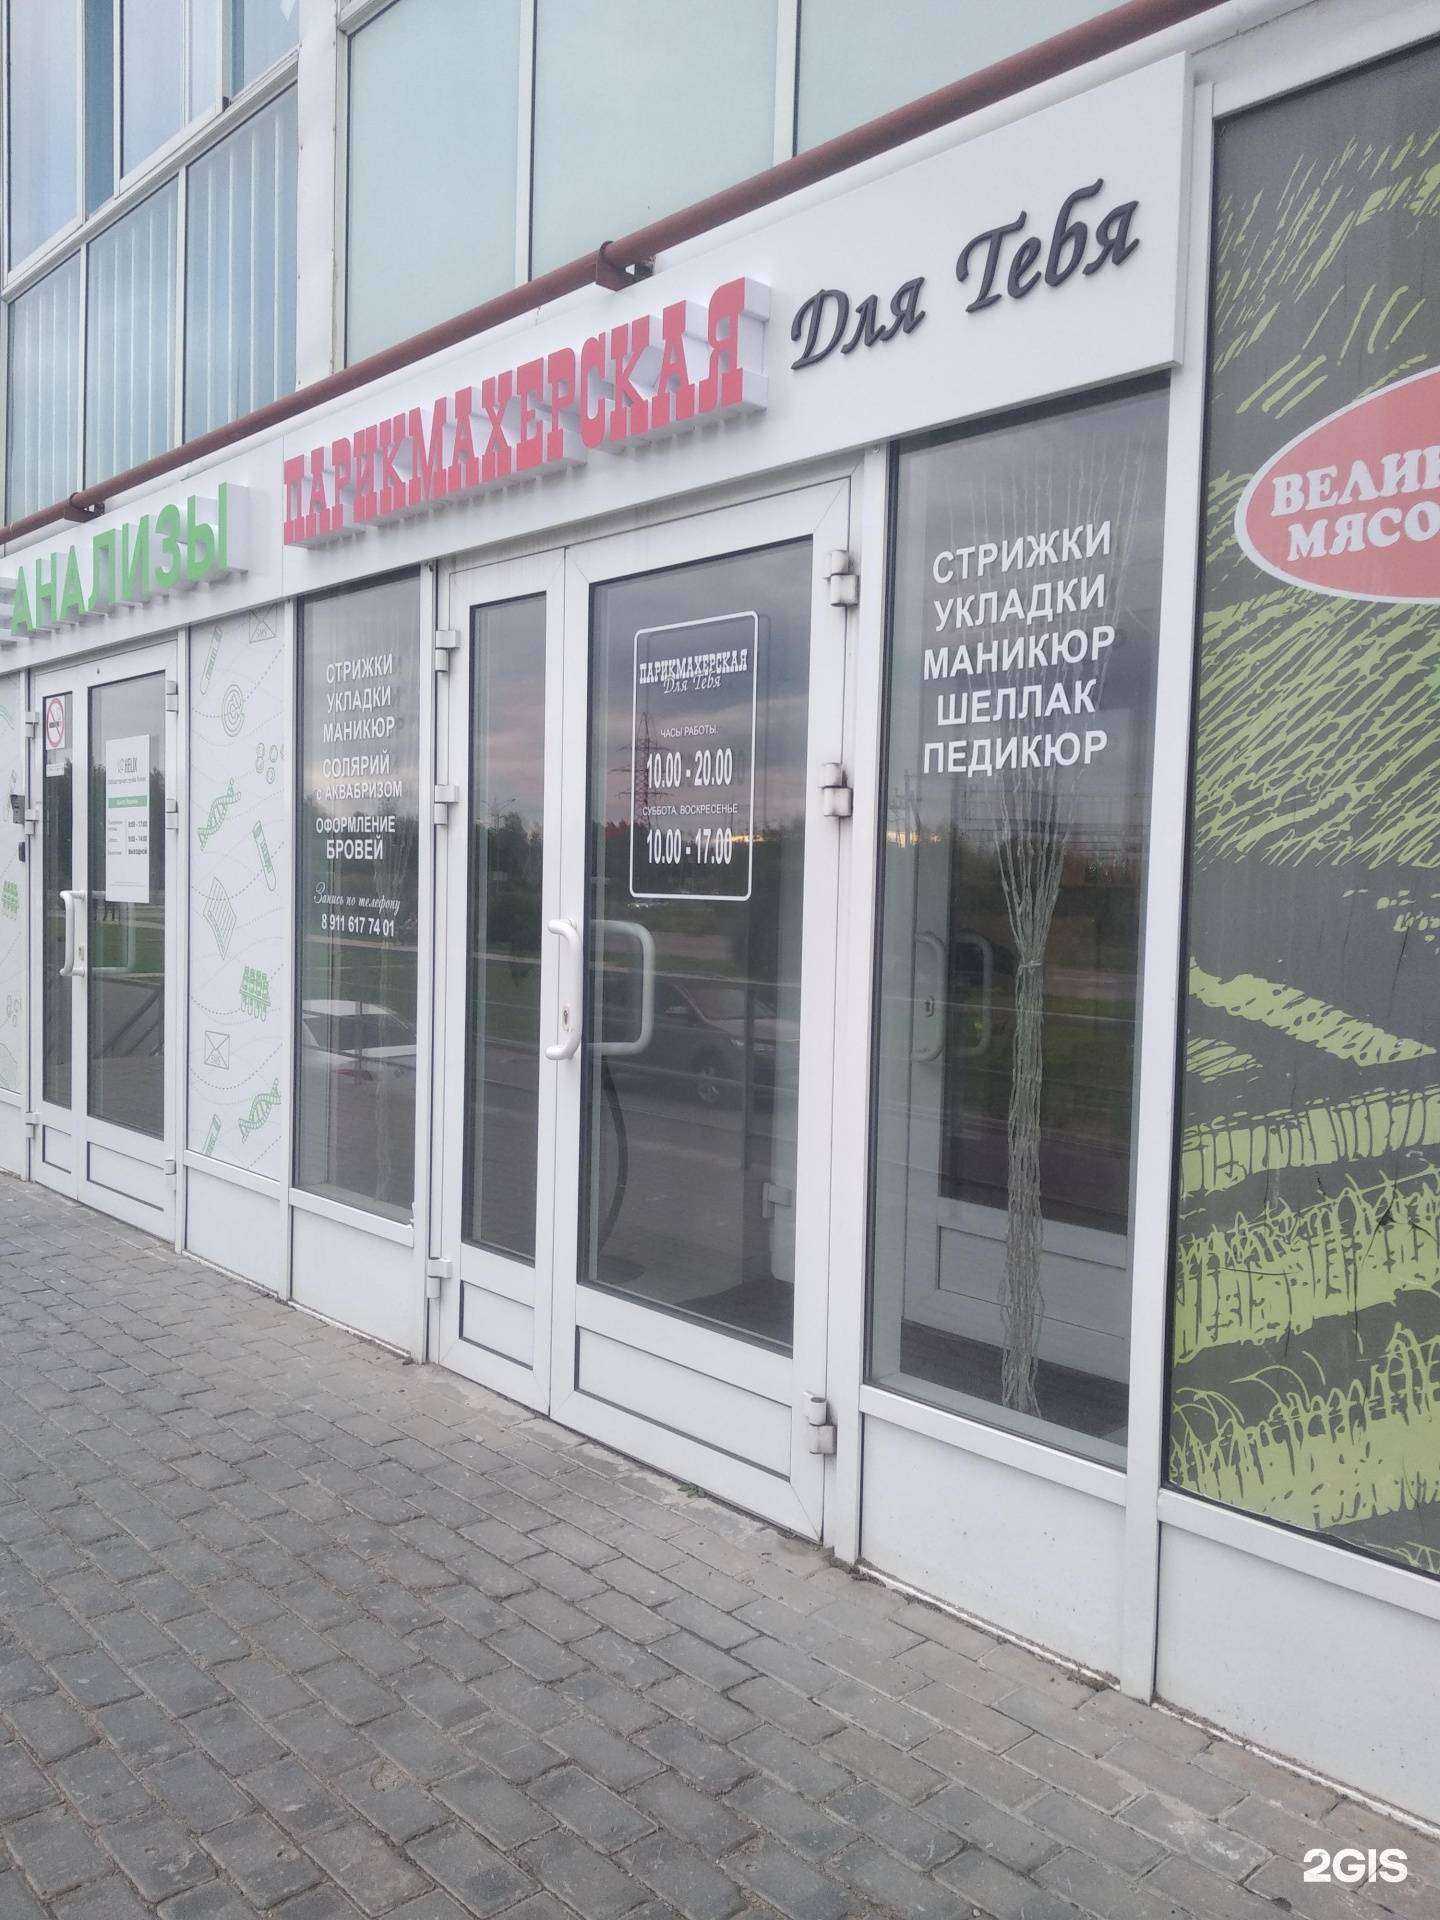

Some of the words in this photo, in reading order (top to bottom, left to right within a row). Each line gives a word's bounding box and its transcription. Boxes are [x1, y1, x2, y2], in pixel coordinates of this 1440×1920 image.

[790, 276, 926, 370] Для
[955, 177, 1140, 313] Тебя
[283, 276, 746, 546] ПАРИКМАХЕРСКАЯ
[10, 481, 229, 636] АНАЛИЗЫ
[932, 520, 1111, 584] СТРИЖКИ
[933, 573, 1105, 632] УКЛАДКИ
[326, 653, 393, 684] СТРИЖКИ
[639, 648, 748, 684] ПАРИКМАХЕРСКАЯ
[923, 625, 1116, 681] МАНИКЮР
[326, 685, 391, 713] УКЛАДКИ
[663, 677, 688, 693] Для
[693, 674, 721, 690] Тебя
[937, 678, 1097, 726] ШЕЛЛАК
[323, 716, 395, 743] МАНИКЮР
[660, 727, 682, 738] ЧАСЫ
[322, 748, 391, 778] СОЛЯРИЙ
[646, 751, 682, 789] 10.00
[694, 747, 733, 786] 20.00
[923, 729, 1108, 778] ПЕДИКЮР
[325, 780, 402, 801] АКВАБРИЗОМ
[316, 815, 395, 834] ОФОРМЛЕНИЕ
[679, 803, 738, 815] ВОСКРЕСЕНЬЕ
[326, 834, 383, 860] БРОВЕЙ
[646, 828, 682, 864] 10.00
[695, 827, 733, 865] 17.00
[313, 881, 344, 905] Запись
[346, 896, 356, 906] по
[358, 895, 401, 916] телефону
[321, 913, 328, 930] 8
[329, 913, 345, 932] 911
[348, 915, 366, 934] 617
[368, 918, 381, 935] 74
[382, 919, 395, 937] 01
